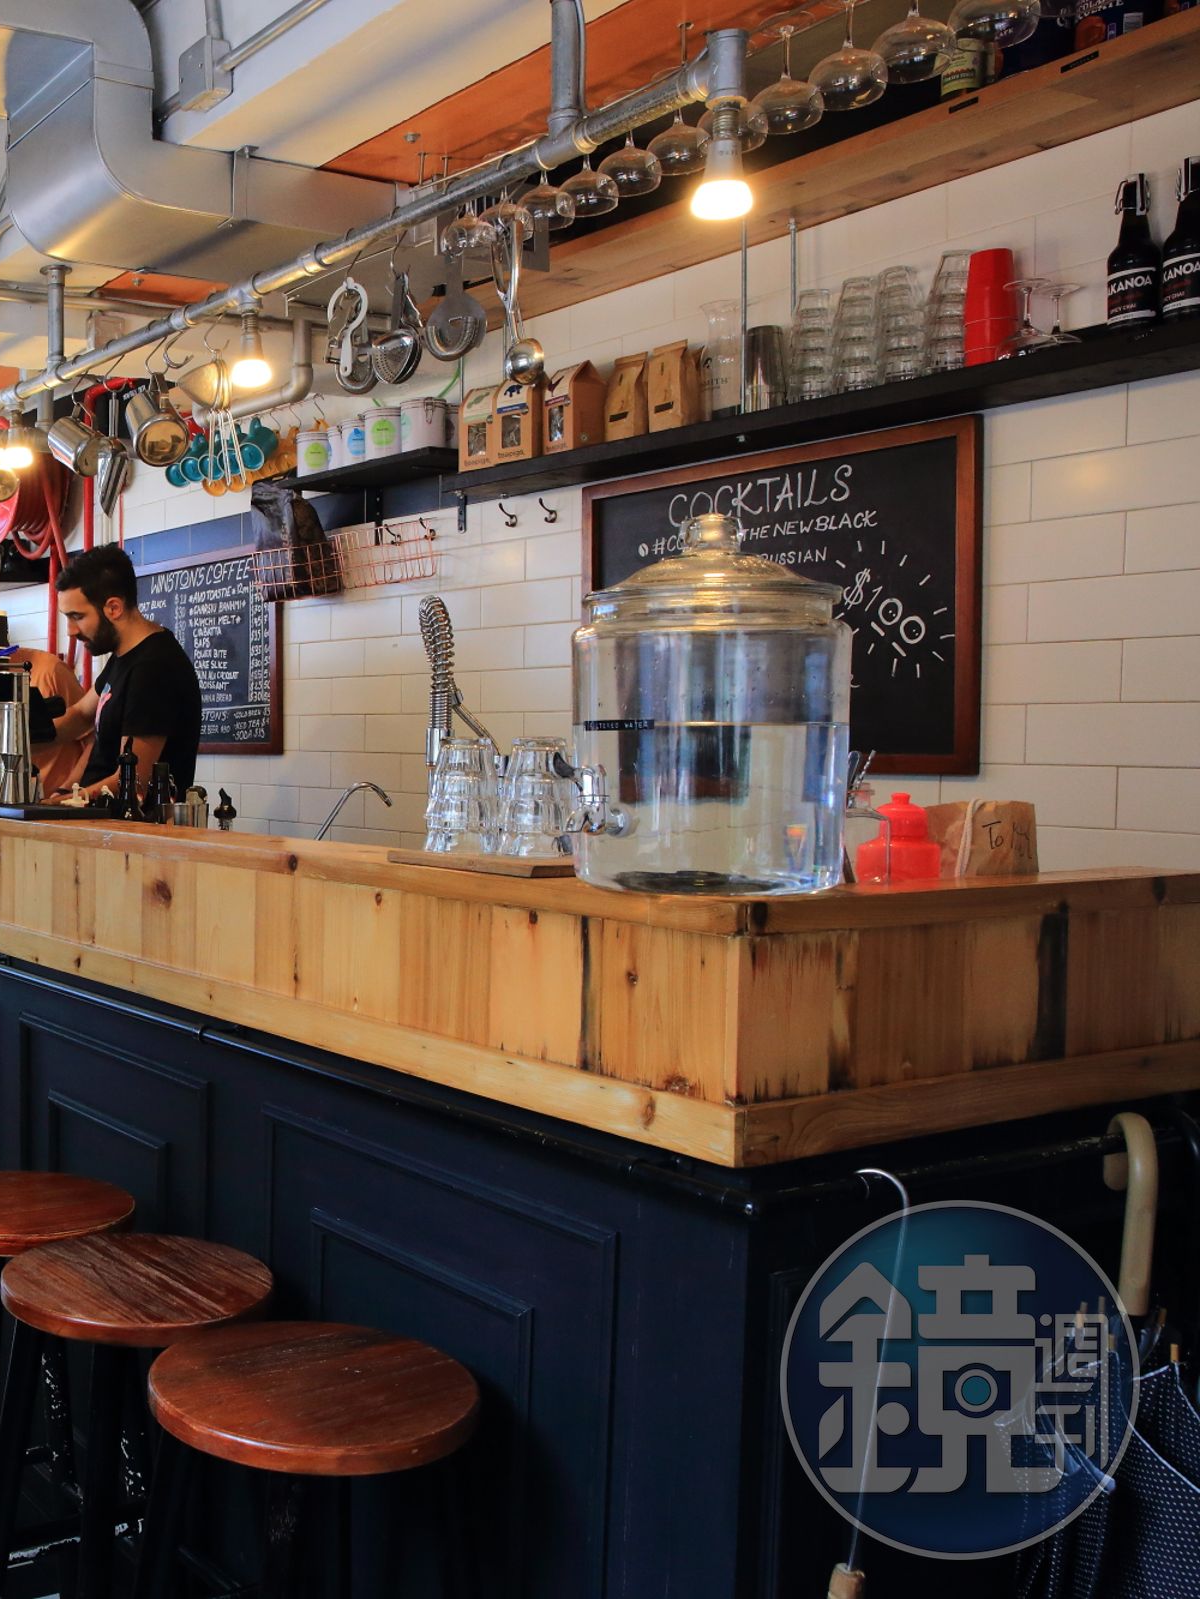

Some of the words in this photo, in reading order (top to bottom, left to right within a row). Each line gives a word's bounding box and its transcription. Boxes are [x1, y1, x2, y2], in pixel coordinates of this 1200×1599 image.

[668, 464, 853, 527] COCKTAILS
[742, 524, 770, 543] THE
[205, 557, 254, 585] COFFEE
[843, 568, 926, 645] $100
[217, 615, 236, 626] MELT
[213, 648, 228, 659] BITE
[193, 660, 210, 669] CAKE
[210, 660, 228, 669] SLICE
[199, 680, 230, 691] ROISSANT
